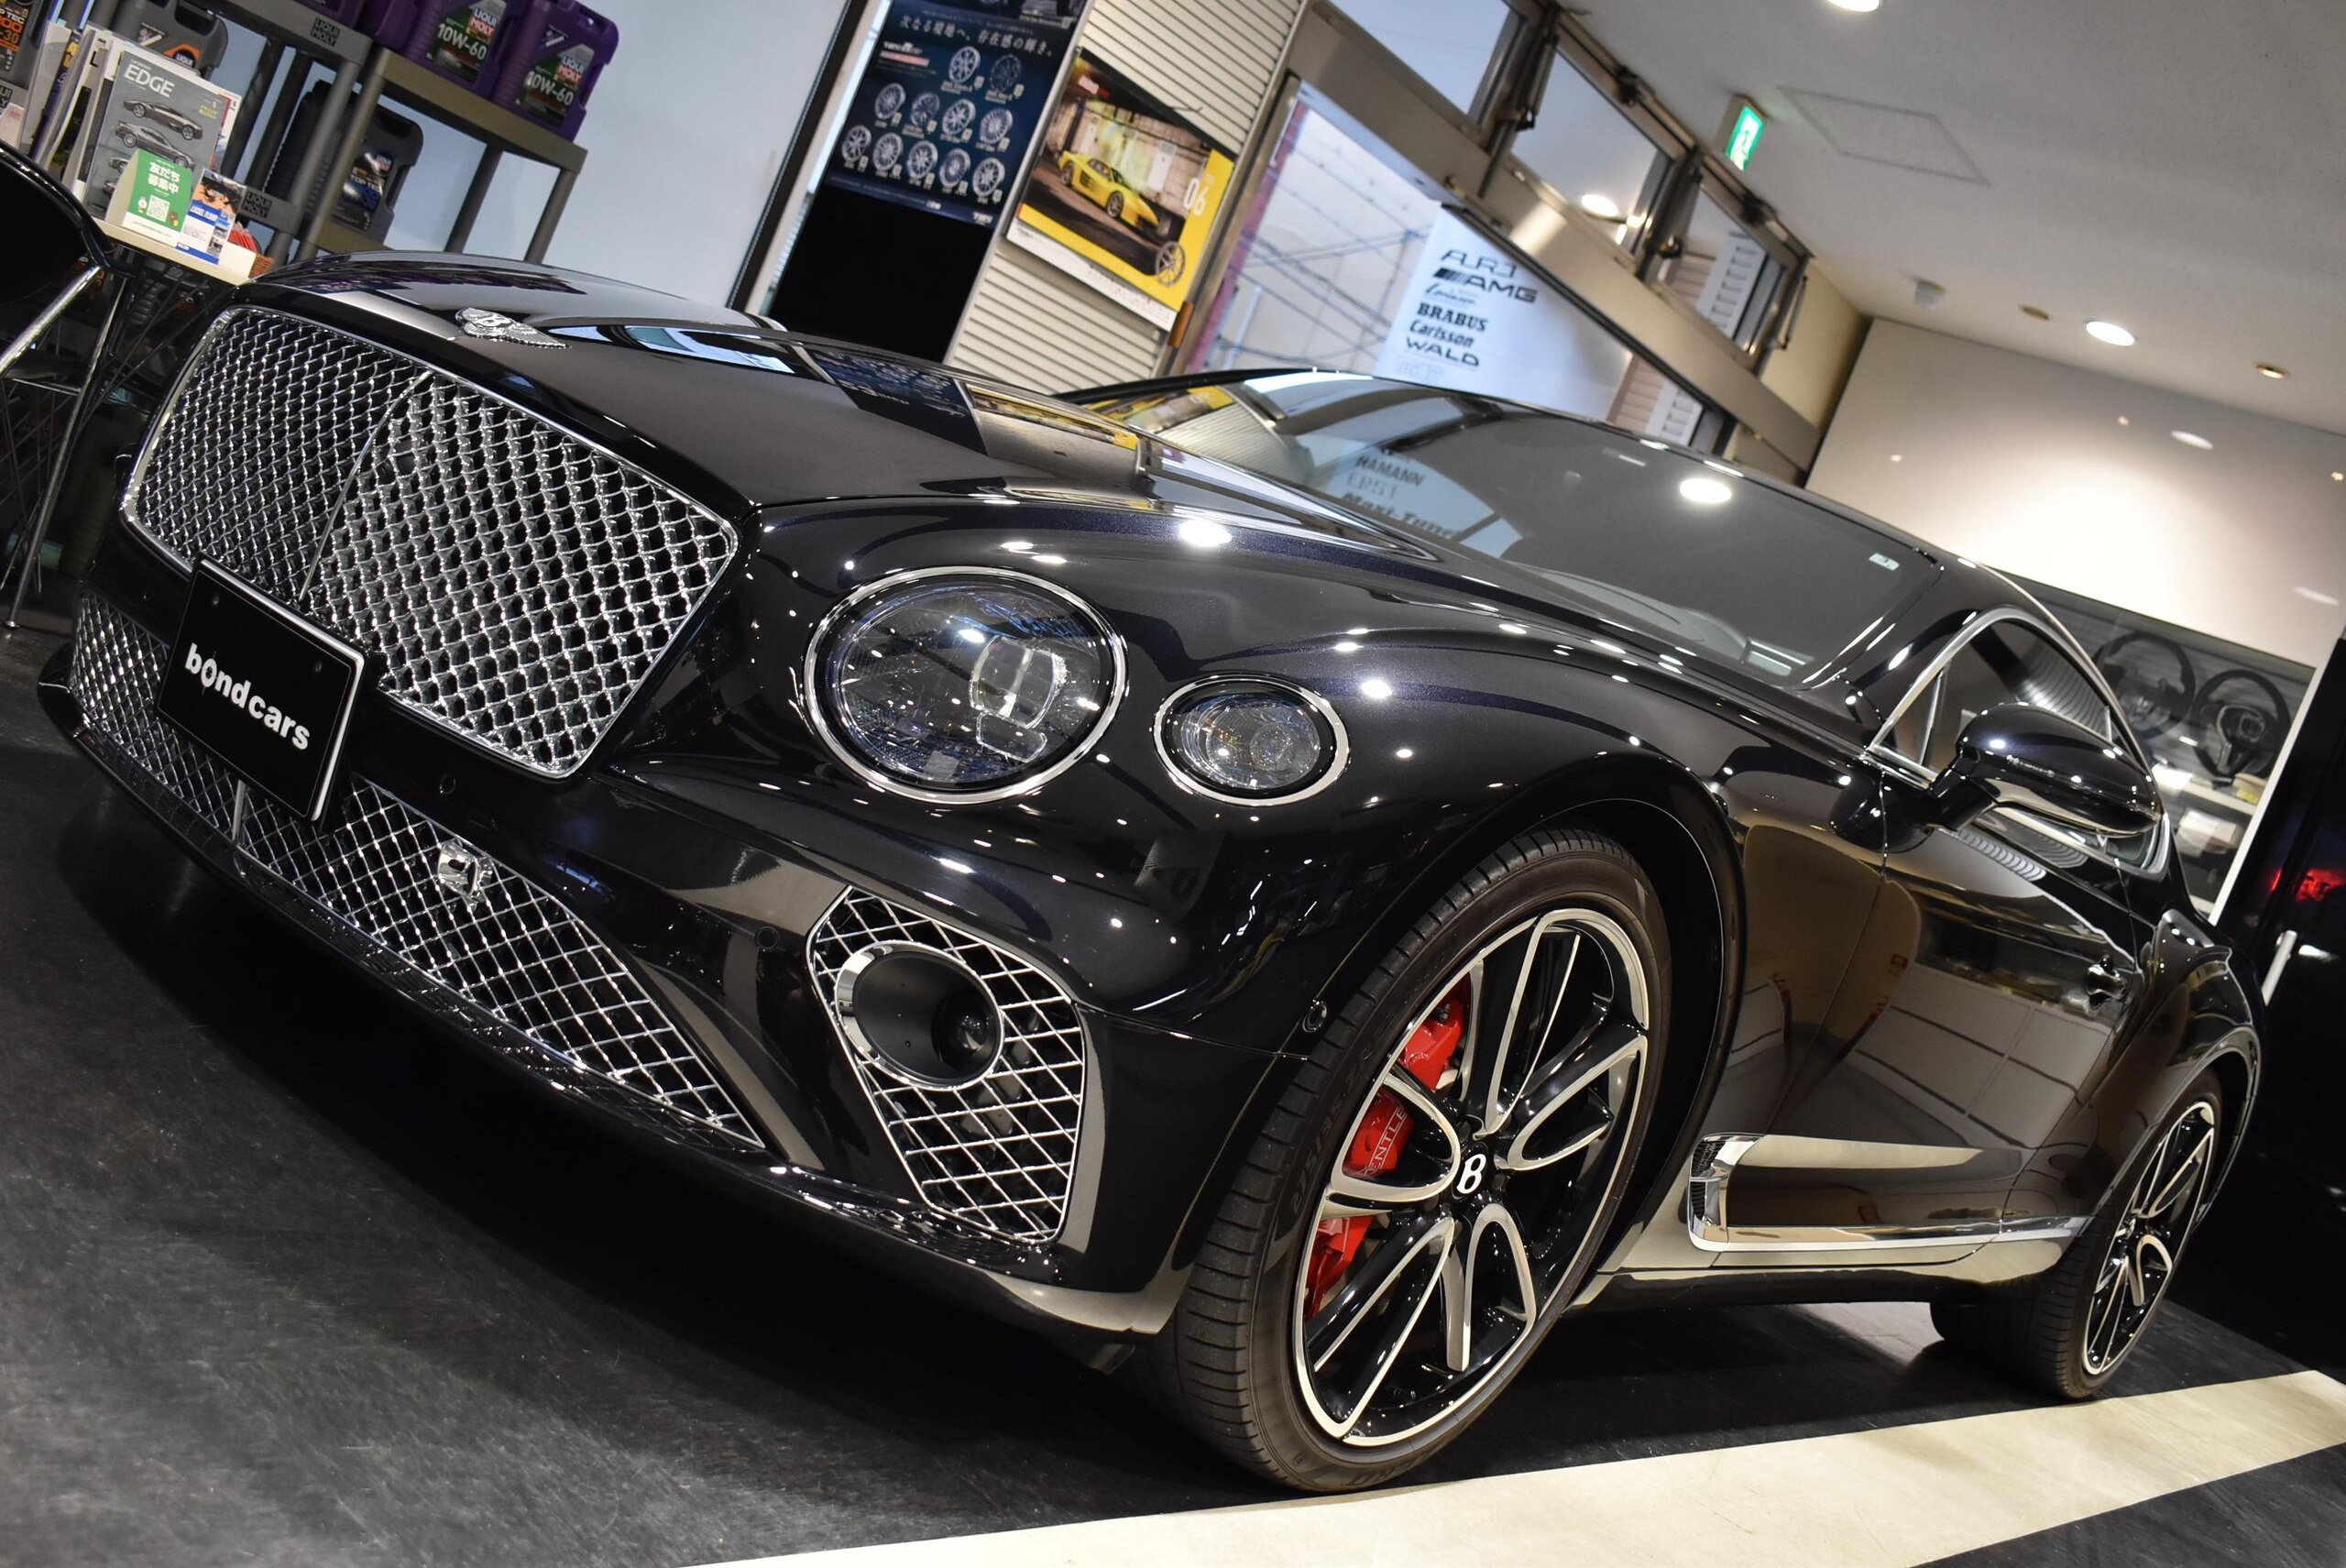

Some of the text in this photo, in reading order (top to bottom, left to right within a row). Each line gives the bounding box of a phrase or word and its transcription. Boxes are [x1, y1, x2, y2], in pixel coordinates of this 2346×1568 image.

[437, 22, 488, 61] 10W-60
[468, 17, 496, 37] MOLY
[124, 63, 176, 99] EDGE
[525, 70, 576, 106] 10W-60
[148, 161, 181, 182] 友だち
[1183, 177, 1208, 216] 06
[1464, 274, 1539, 304] AMG
[1409, 318, 1475, 349] Carlsson
[1417, 302, 1489, 334] BRABUS
[1406, 336, 1480, 368] WALD
[1456, 1153, 1487, 1194] B
